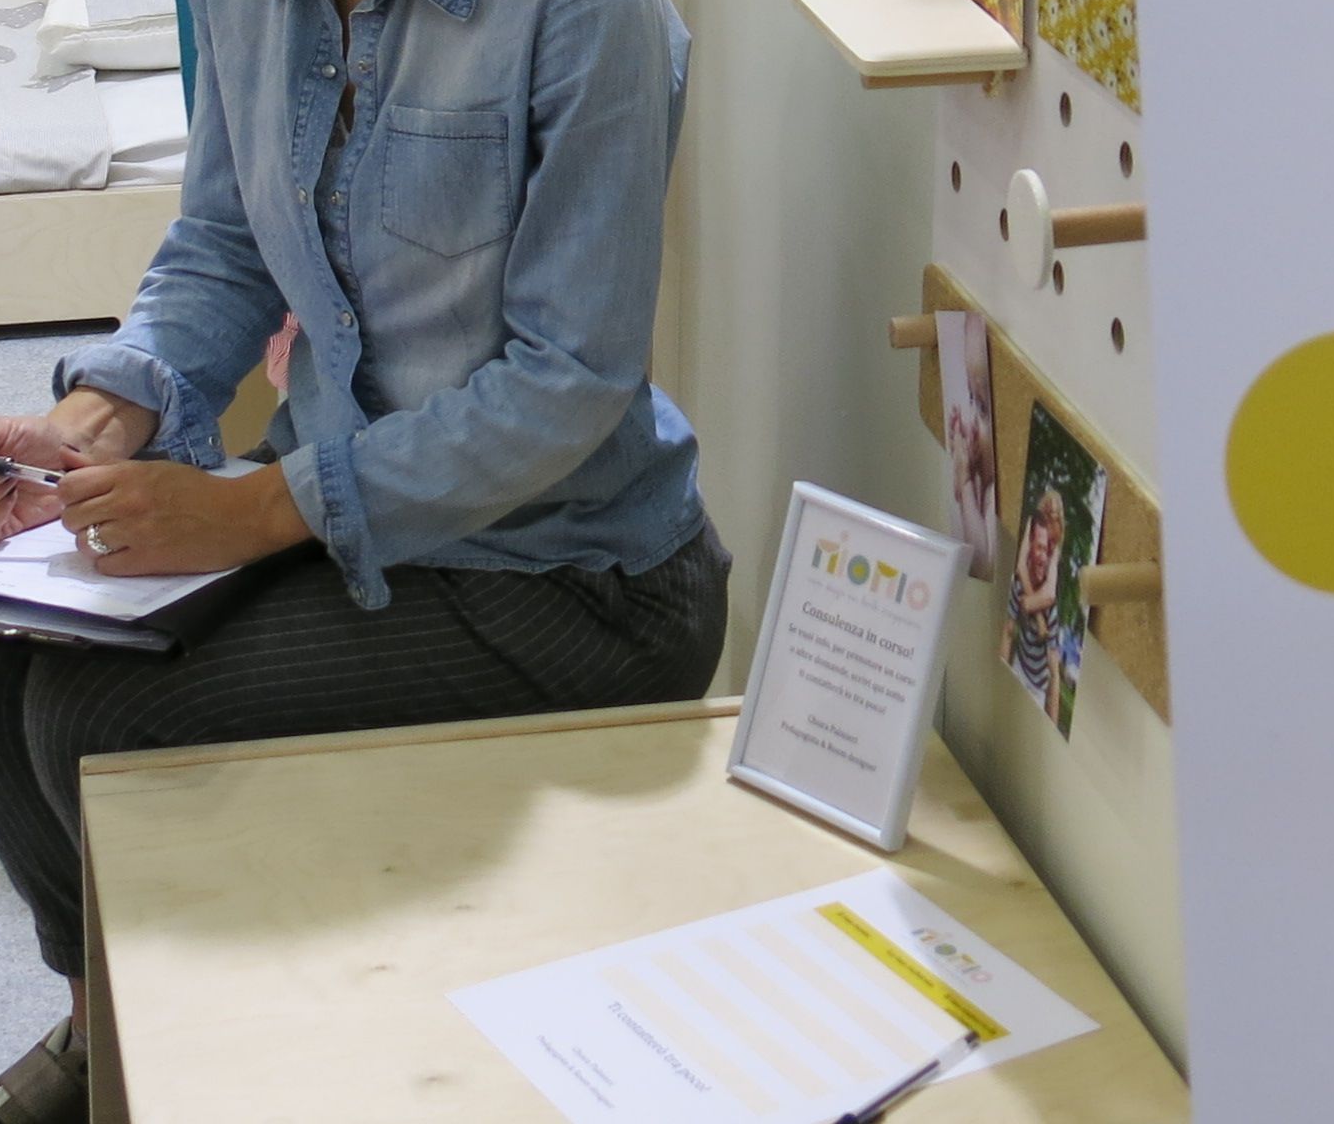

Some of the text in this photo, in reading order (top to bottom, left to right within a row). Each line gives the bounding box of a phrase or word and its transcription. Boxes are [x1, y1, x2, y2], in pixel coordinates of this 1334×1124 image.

[802, 600, 864, 638] Consulenza
[866, 628, 878, 644] in
[879, 637, 915, 660] corso!
